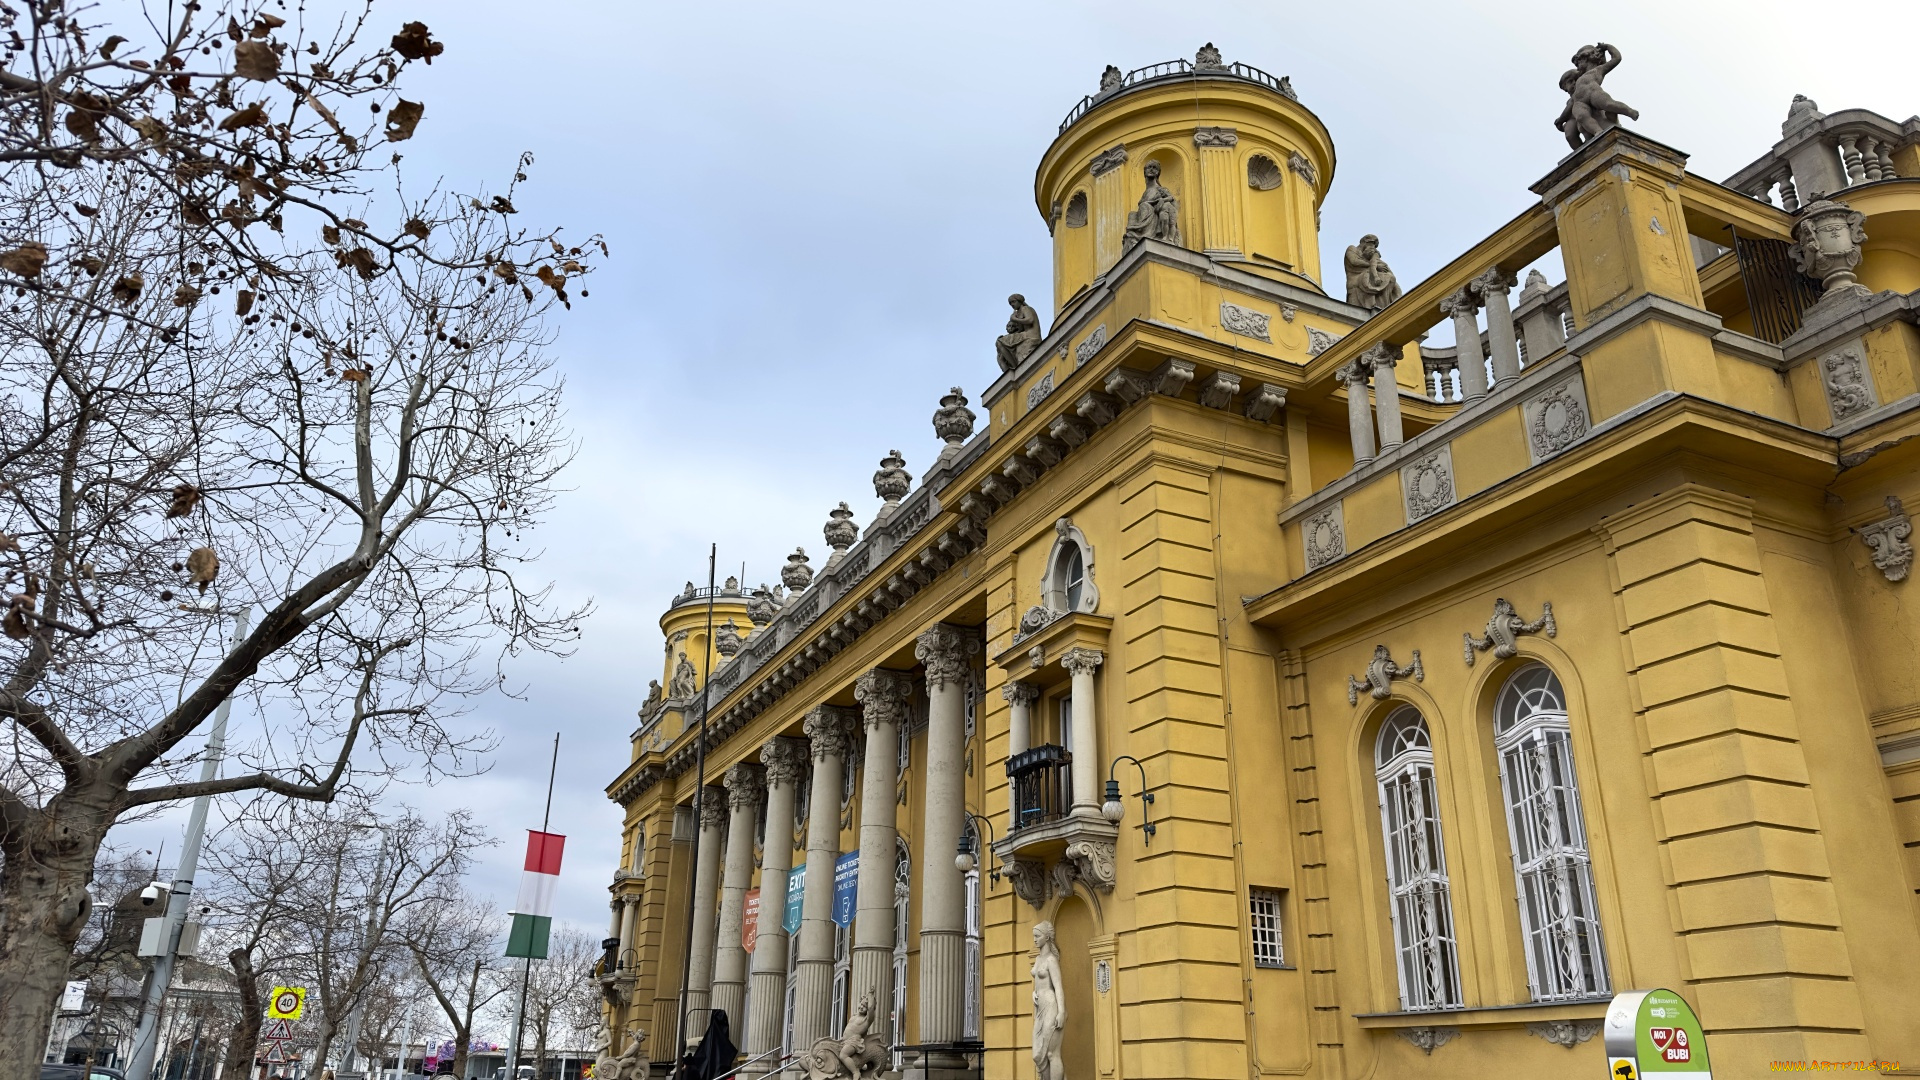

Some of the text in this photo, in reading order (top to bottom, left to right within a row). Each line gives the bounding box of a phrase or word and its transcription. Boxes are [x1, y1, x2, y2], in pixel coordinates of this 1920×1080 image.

[849, 868, 859, 878] ENTR
[789, 871, 806, 892] EXIT
[281, 999, 293, 1007] 40
[1653, 1031, 1666, 1039] MOL
[1667, 1049, 1689, 1060] BUBI
